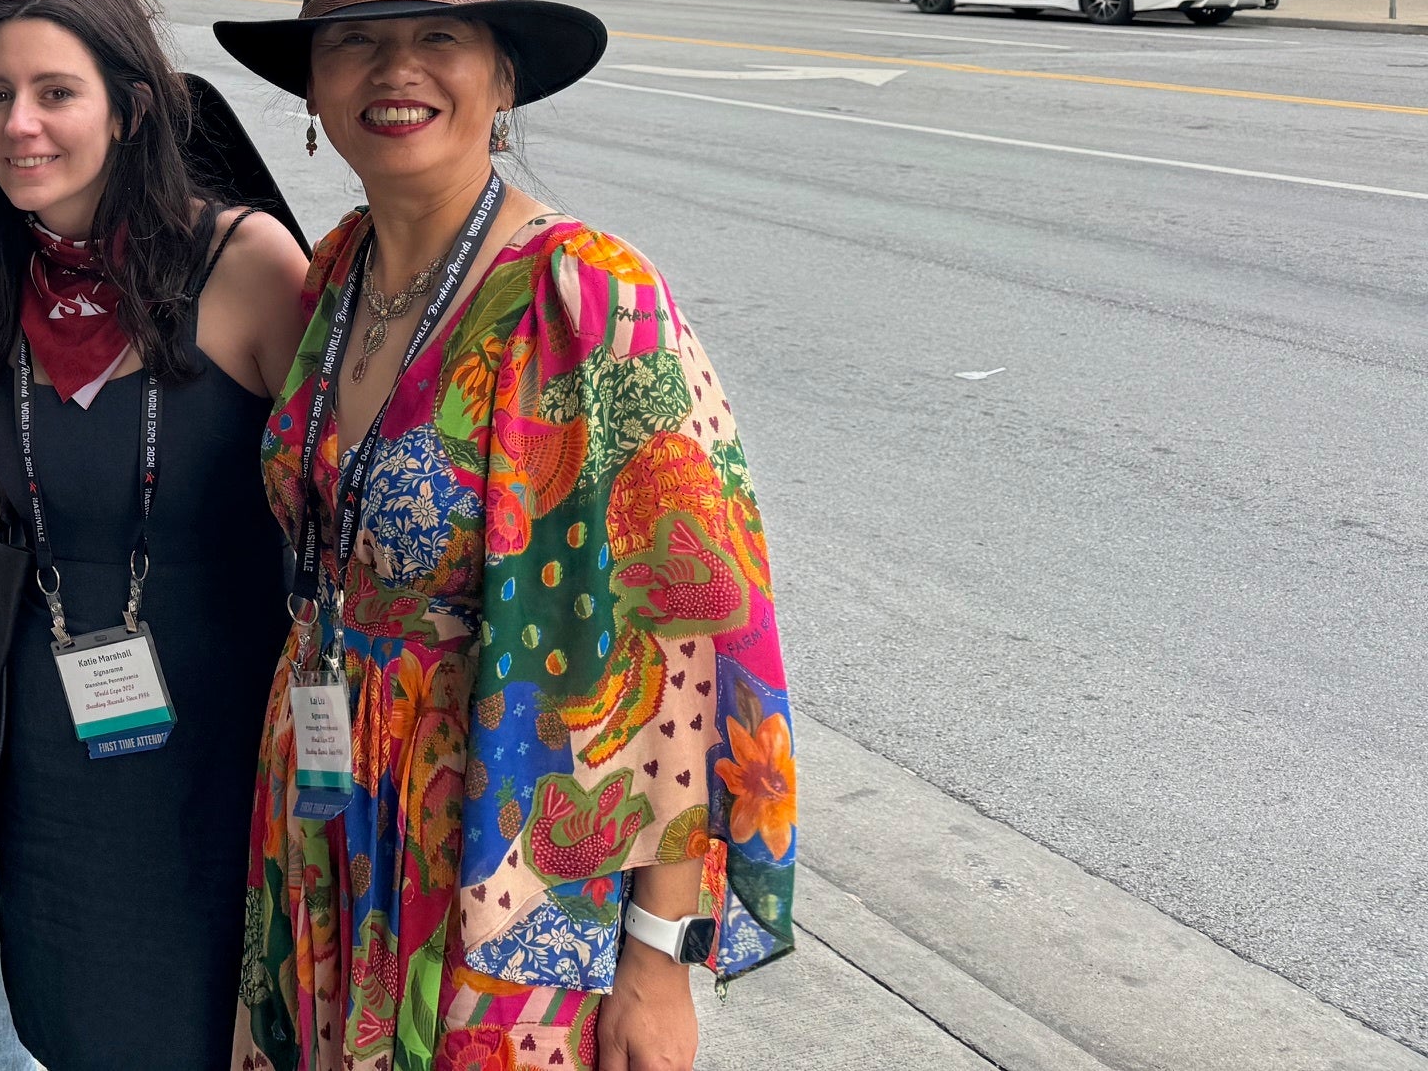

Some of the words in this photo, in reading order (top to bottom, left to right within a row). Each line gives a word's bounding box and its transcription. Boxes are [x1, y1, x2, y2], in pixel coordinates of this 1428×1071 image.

[466, 209, 488, 237] WORLD
[482, 191, 497, 211] EXPO
[322, 326, 343, 375] NASHVILLE
[21, 401, 30, 430] WORLD
[148, 389, 158, 419] WORLD
[147, 421, 157, 443] EXPO
[306, 420, 318, 444] EXPO
[312, 395, 324, 418] 2024
[22, 432, 31, 454] EXPO
[360, 436, 375, 462] EXPO
[25, 456, 34, 478] 2024
[146, 446, 156, 468] 2024
[350, 463, 364, 488] 2024
[32, 497, 45, 543] NASHVILLE
[340, 509, 355, 559] NASHVILLE
[77, 658, 98, 668] Katie
[98, 649, 133, 664] Marshall
[98, 741, 118, 753] FIRST
[118, 738, 136, 749] TIME
